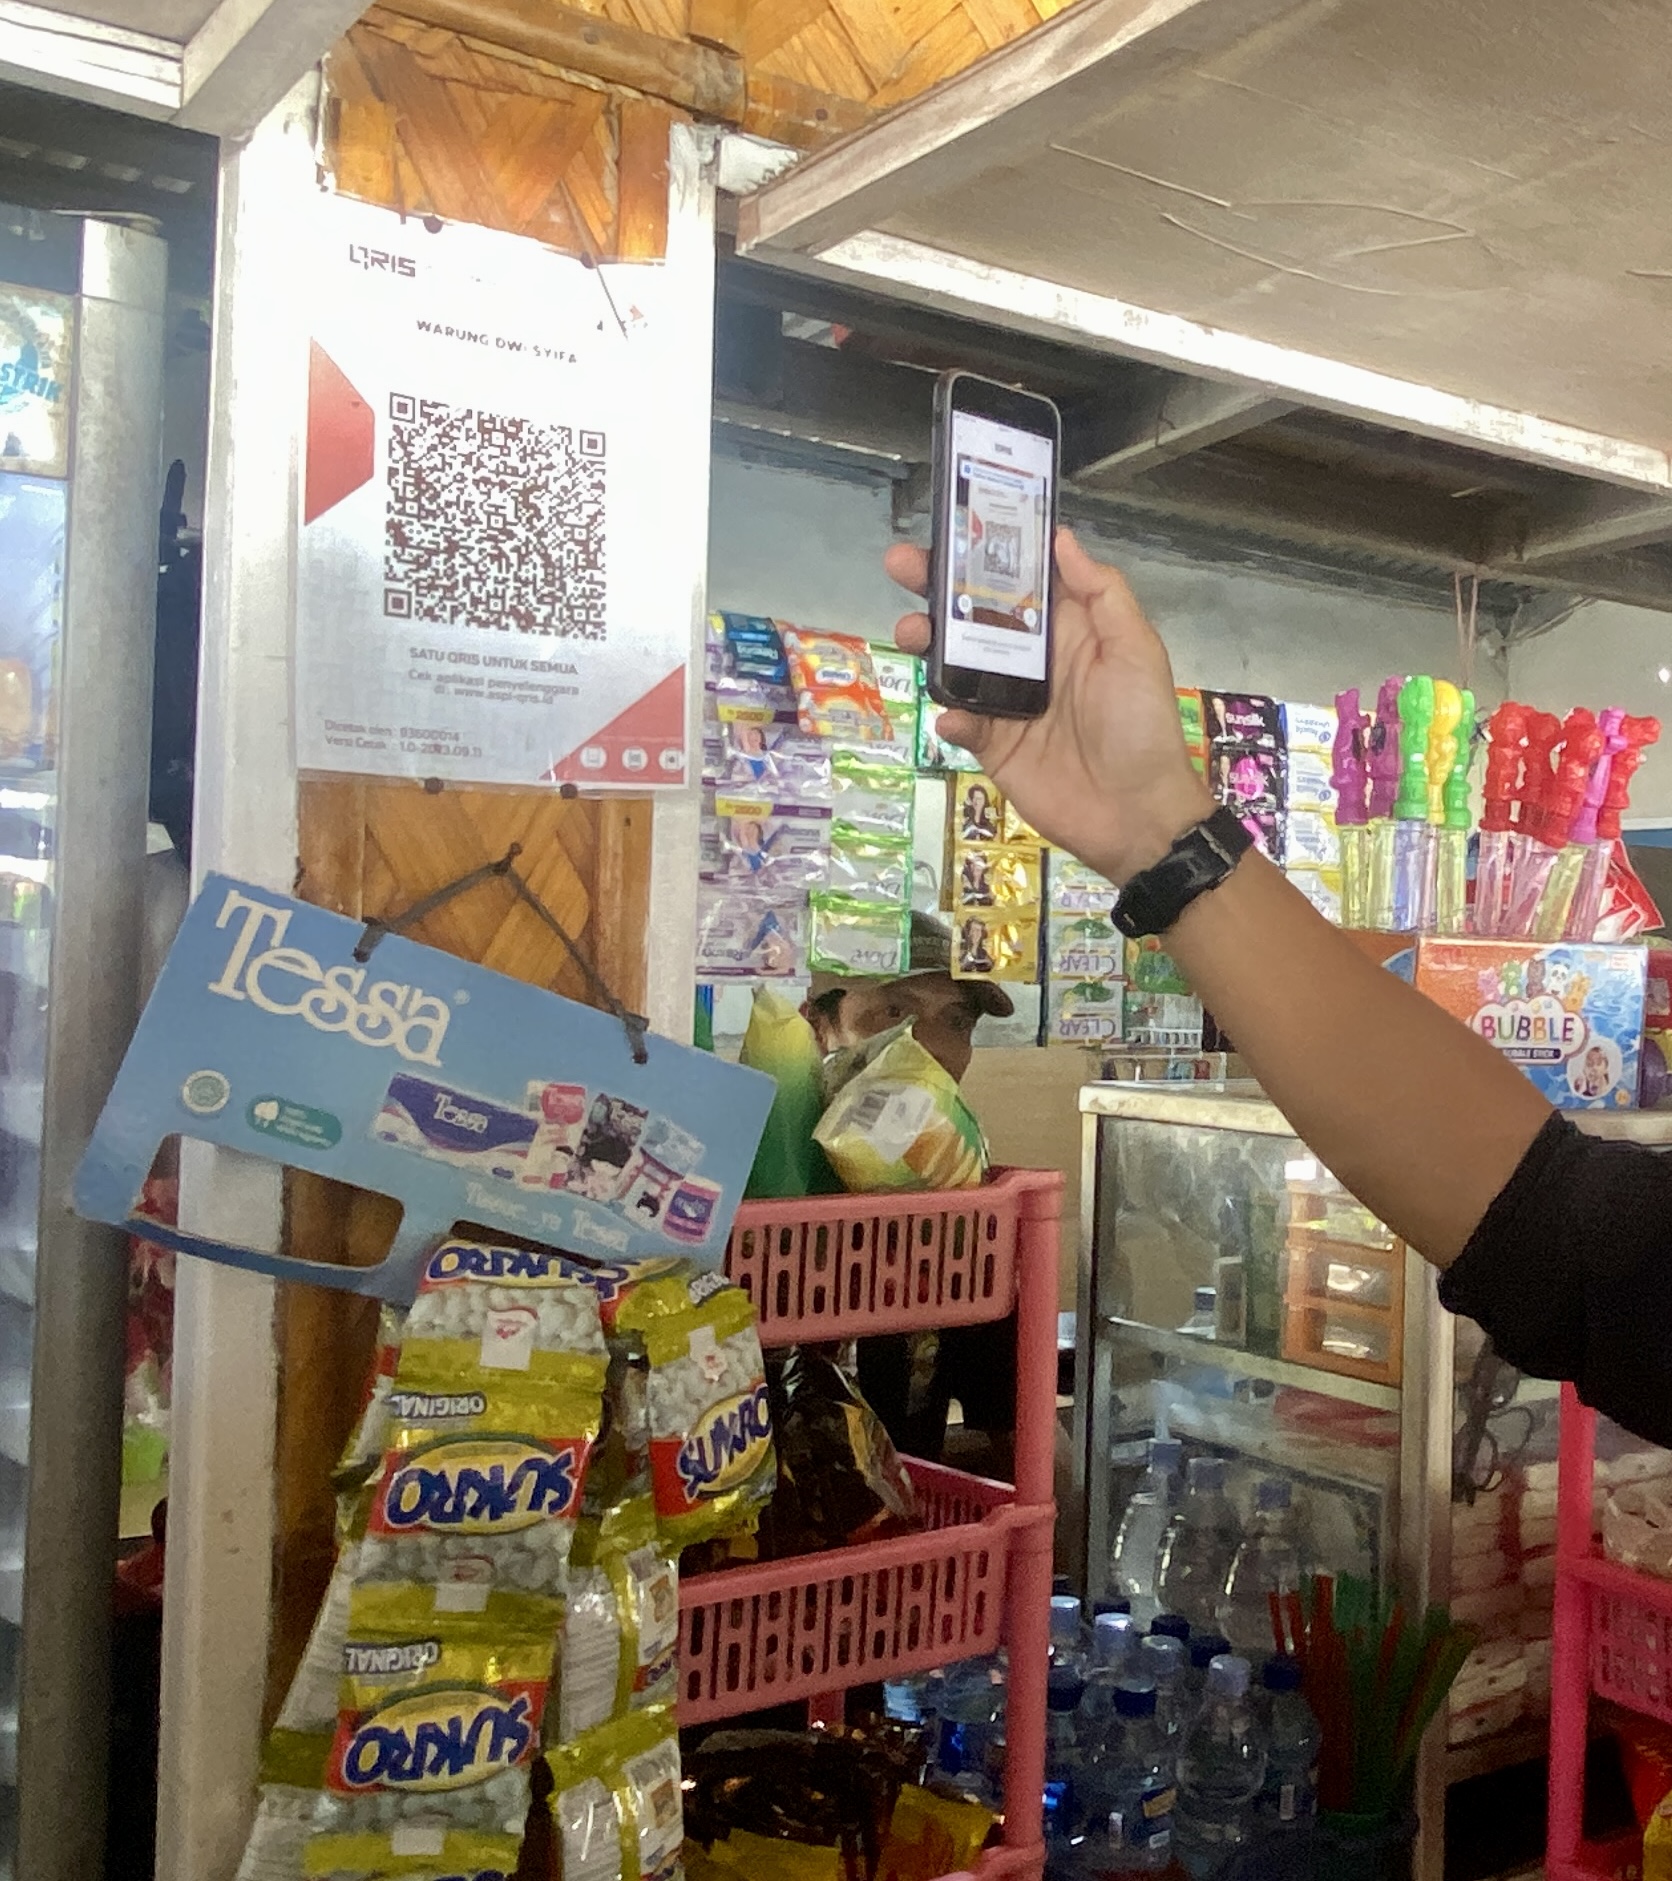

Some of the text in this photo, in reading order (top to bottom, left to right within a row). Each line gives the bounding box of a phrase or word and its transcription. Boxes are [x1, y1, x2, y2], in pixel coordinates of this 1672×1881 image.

[349, 243, 417, 278] QRIS
[416, 319, 490, 346] WARUNG
[408, 646, 579, 676] SATU QRIS UNTUK SEMUA
[208, 888, 452, 1067] Tessa
[1058, 954, 1117, 976] CLEAR
[1058, 1018, 1117, 1039] CLEAR
[1480, 1015, 1575, 1043] BUBBLE
[432, 1091, 491, 1135] Tessa
[385, 1446, 576, 1526] SUKRO
[344, 1640, 440, 1675] ORIGINAL
[343, 1692, 532, 1786] SUKRO
